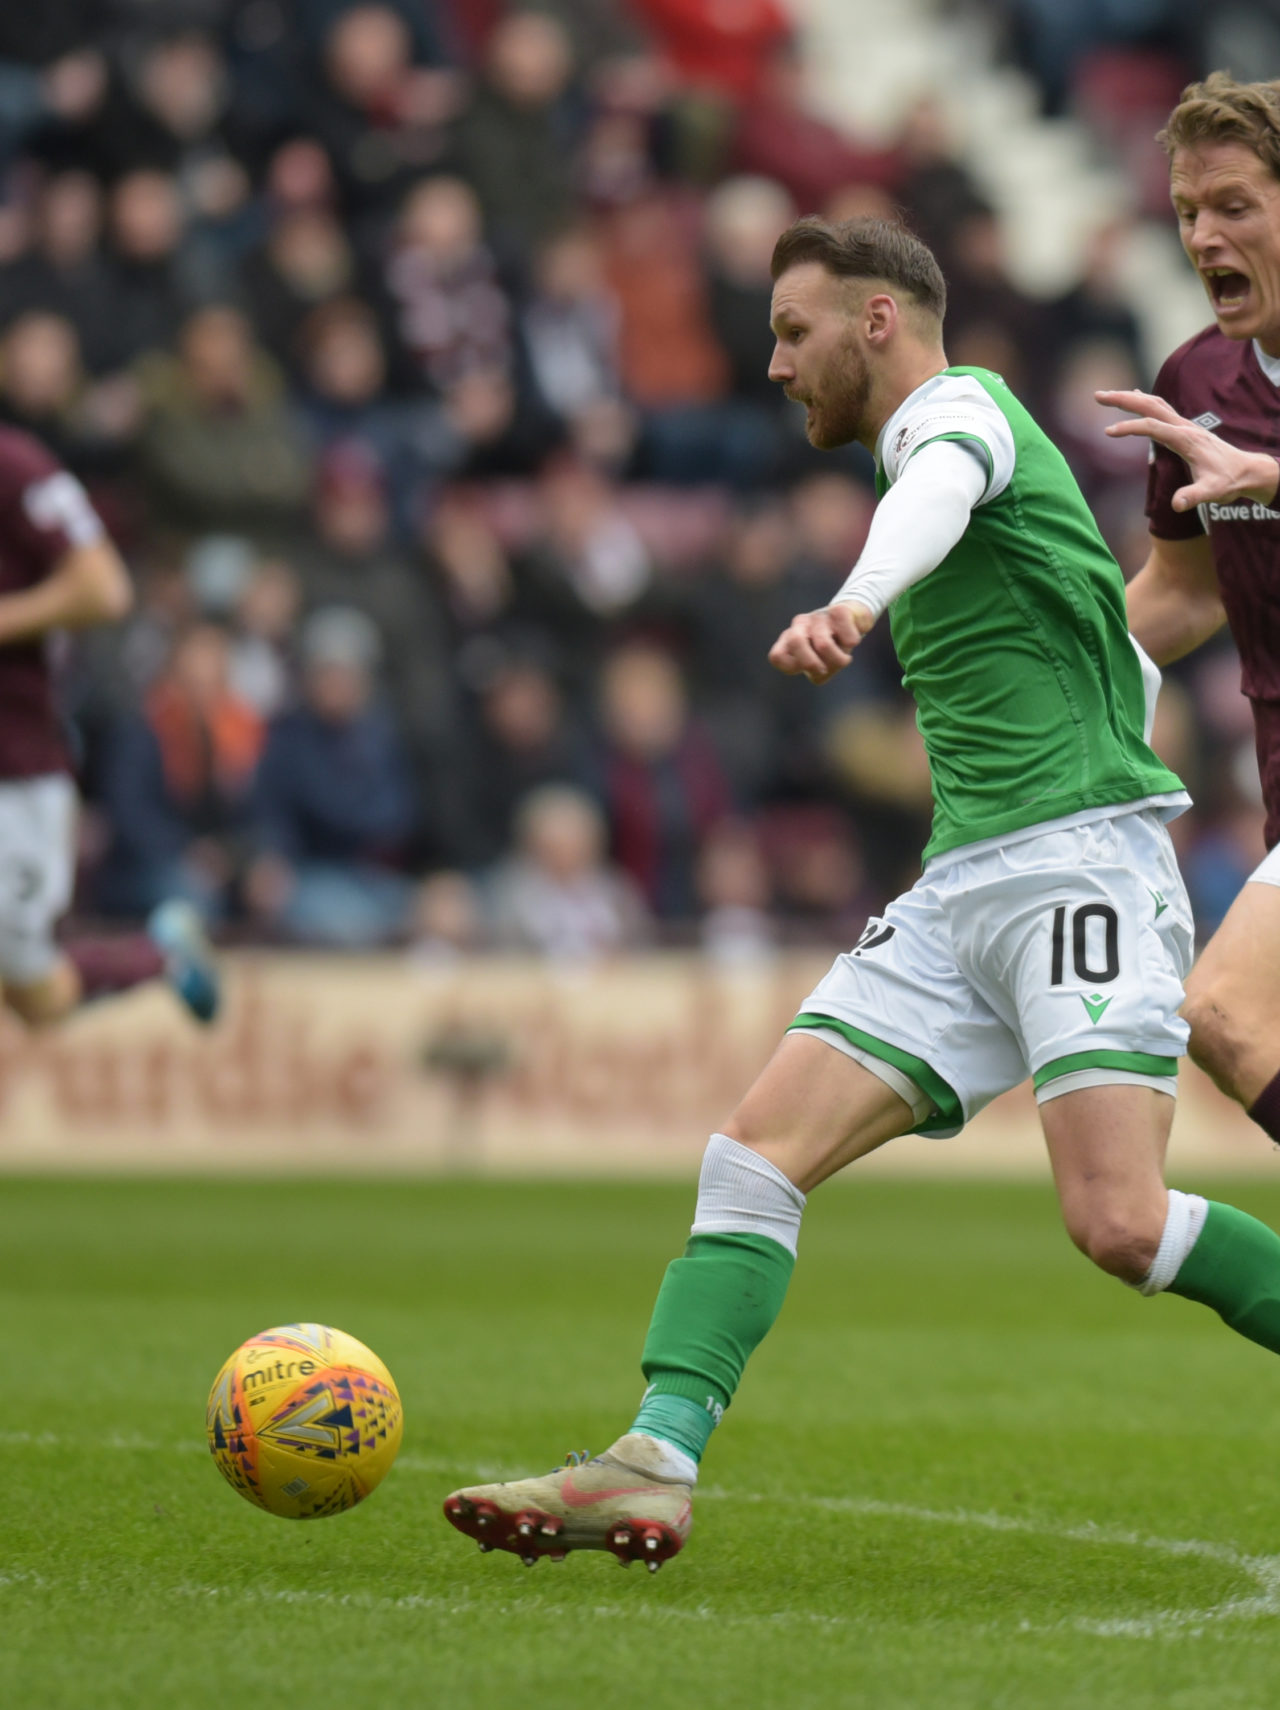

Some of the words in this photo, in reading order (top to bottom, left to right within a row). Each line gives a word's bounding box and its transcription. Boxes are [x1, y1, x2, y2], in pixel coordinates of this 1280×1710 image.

[1209, 502, 1250, 521] Save
[1051, 903, 1120, 986] 10
[242, 1360, 315, 1392] mitre
